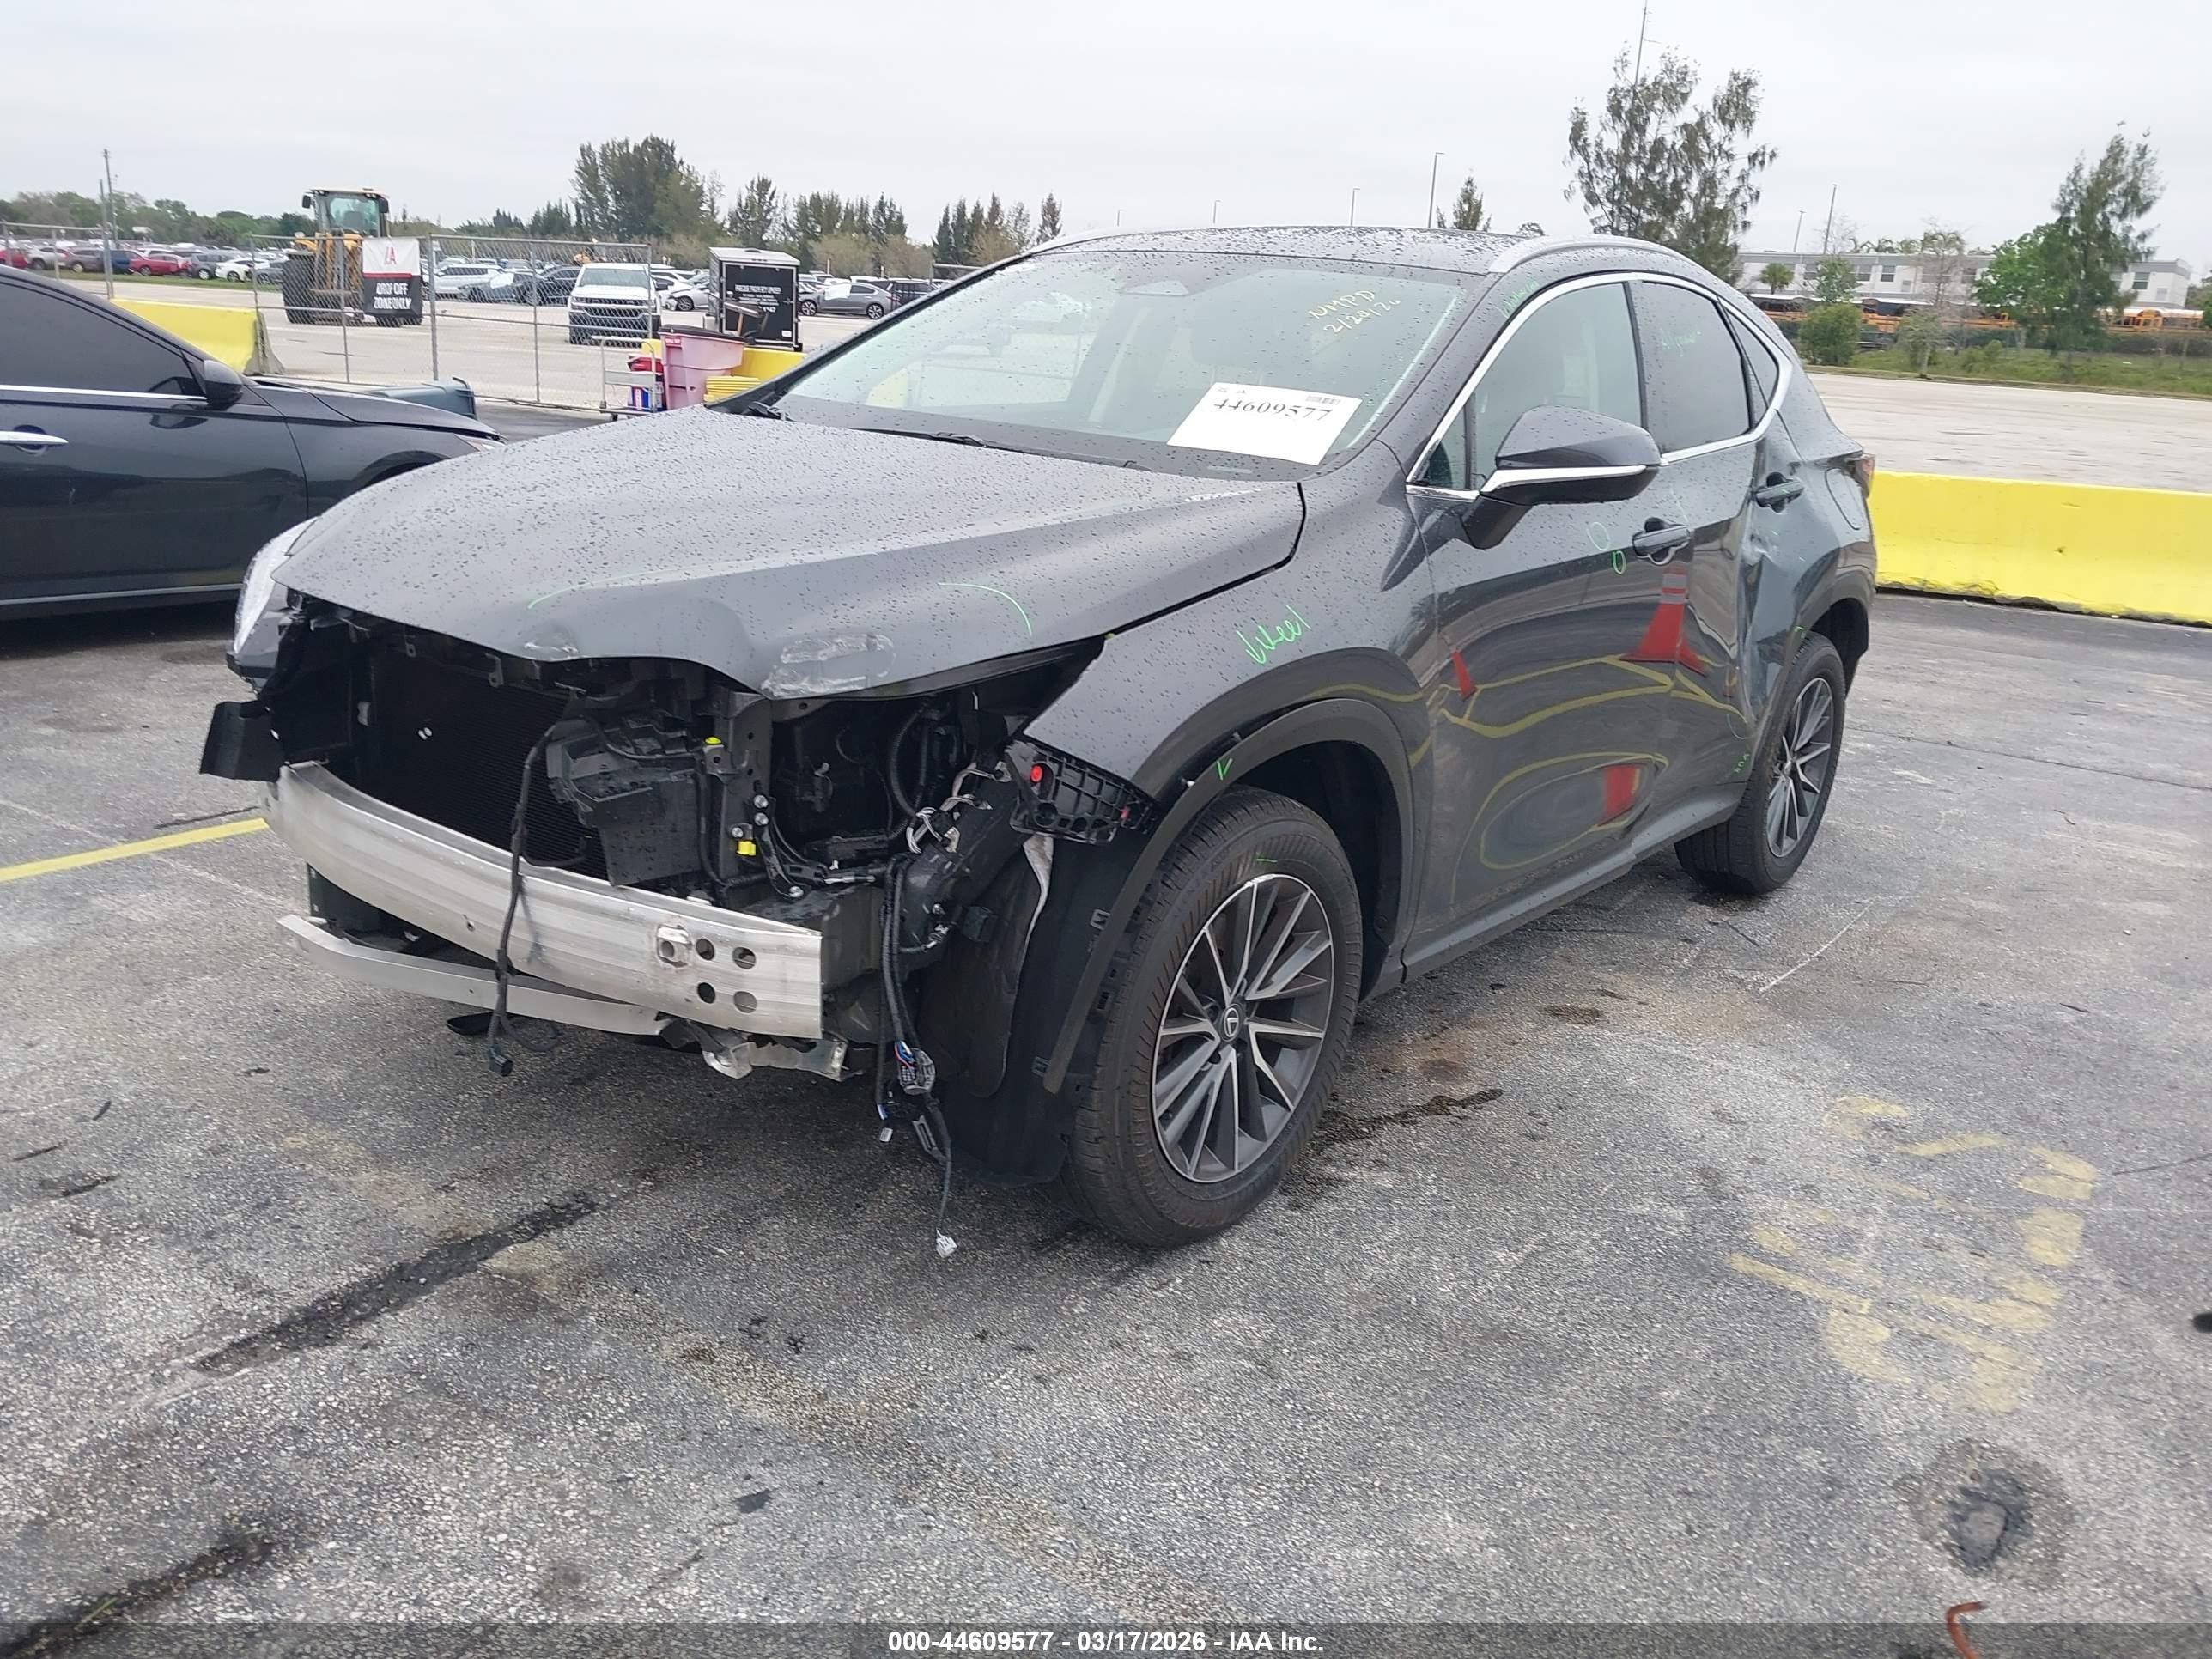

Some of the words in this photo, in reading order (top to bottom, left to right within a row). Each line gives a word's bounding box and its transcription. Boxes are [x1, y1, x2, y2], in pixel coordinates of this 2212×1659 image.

[376, 283, 393, 295] DROP
[393, 283, 409, 295] OFF
[374, 296, 392, 309] ZONE
[392, 297, 412, 309] ONLY
[1213, 398, 1333, 421] 44609577
